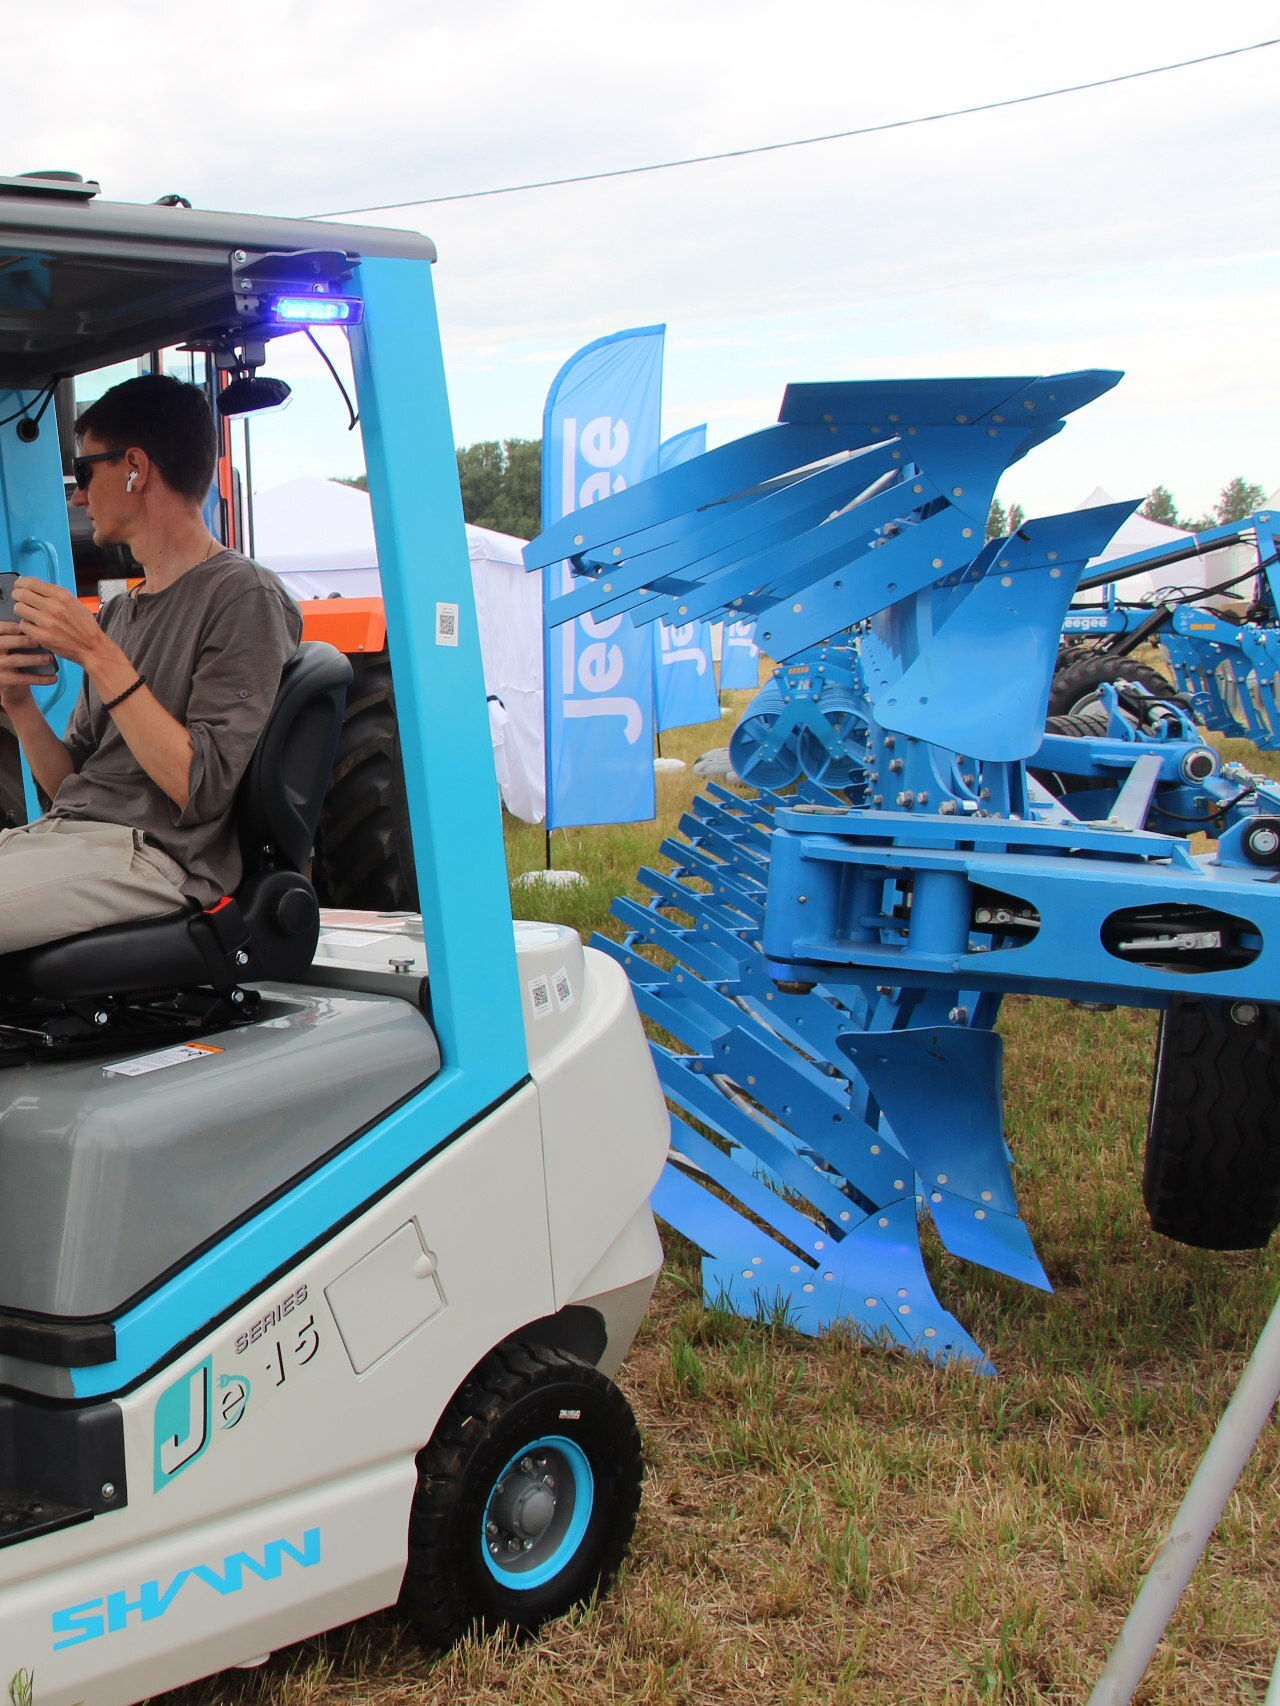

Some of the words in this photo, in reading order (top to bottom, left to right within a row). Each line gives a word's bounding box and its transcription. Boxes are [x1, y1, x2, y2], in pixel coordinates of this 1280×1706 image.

[562, 415, 643, 745] Jeee
[234, 1283, 308, 1355] SERIES
[53, 1527, 321, 1652] SHANN
